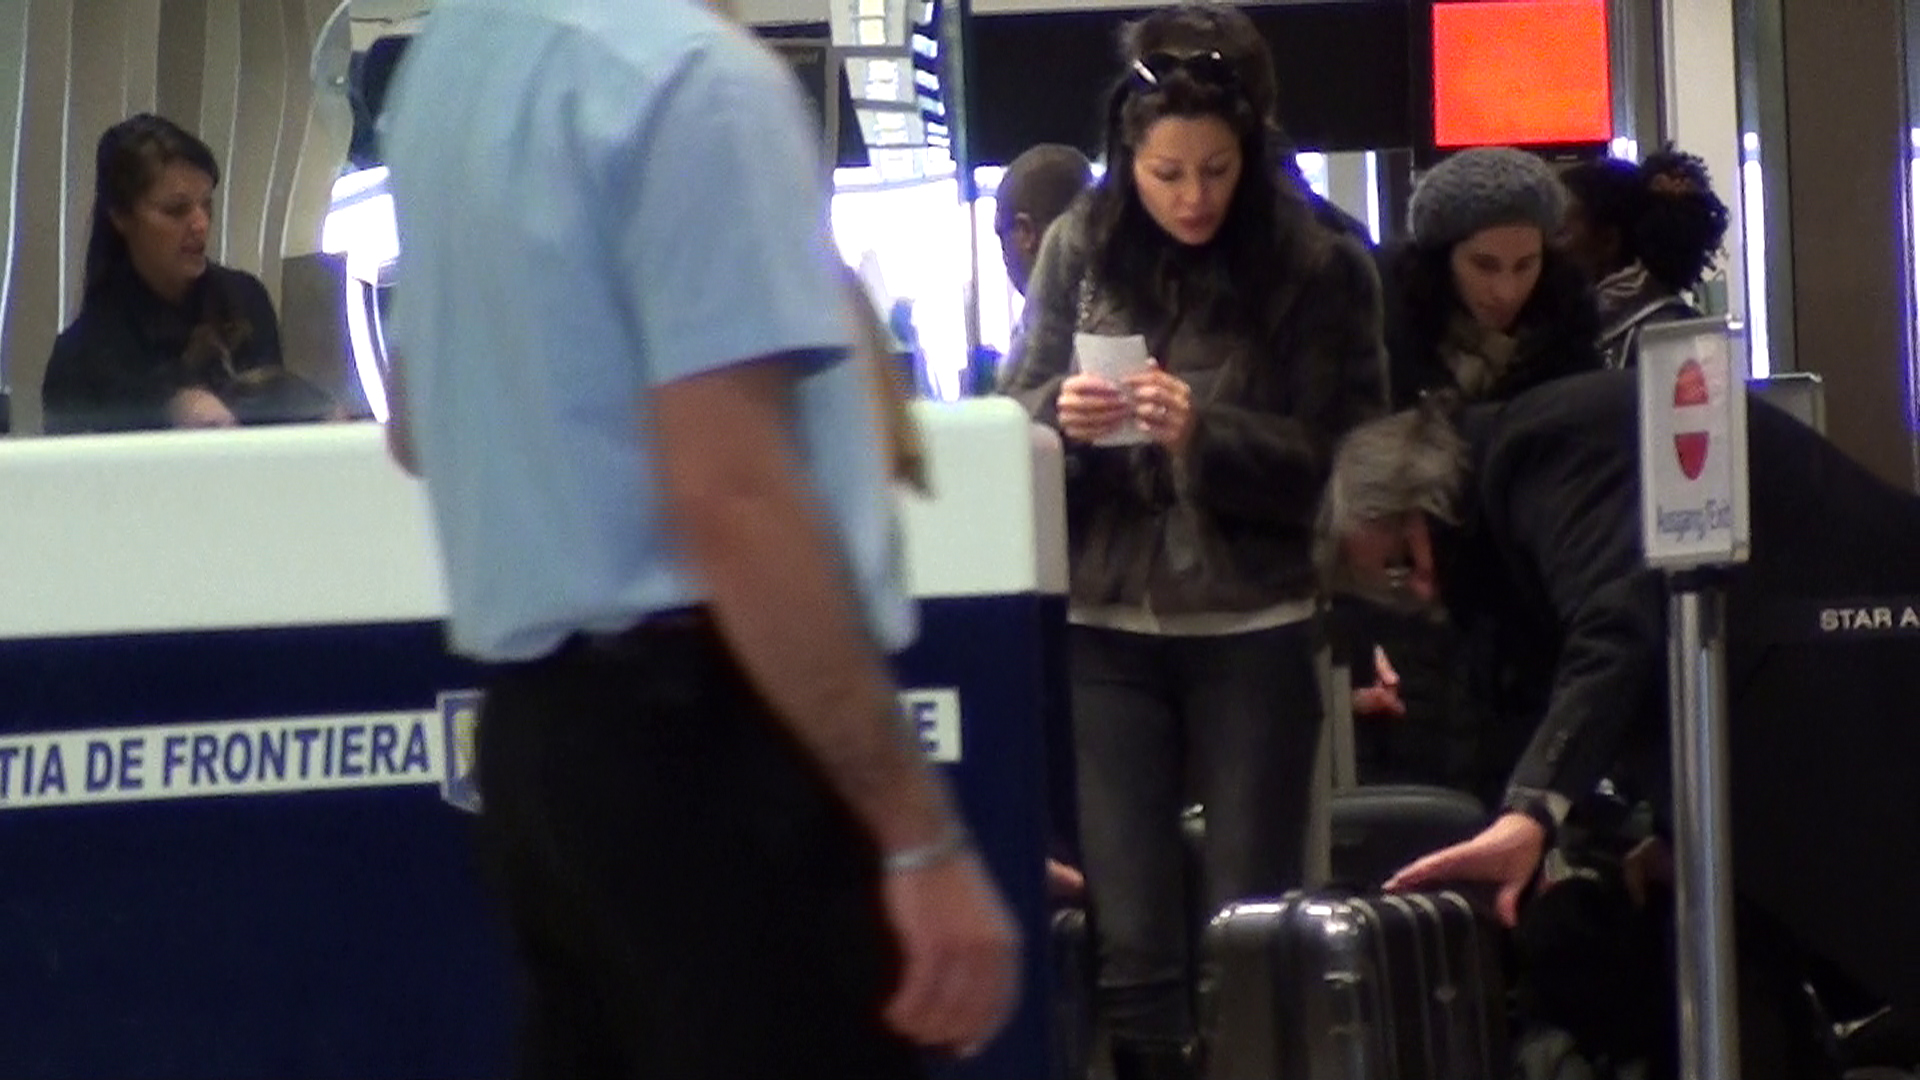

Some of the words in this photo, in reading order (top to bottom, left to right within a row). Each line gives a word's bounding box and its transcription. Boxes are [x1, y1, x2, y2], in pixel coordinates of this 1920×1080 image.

[1820, 607, 1892, 631] STAR
[86, 738, 144, 792] DE
[163, 721, 430, 787] FRONTIERA
